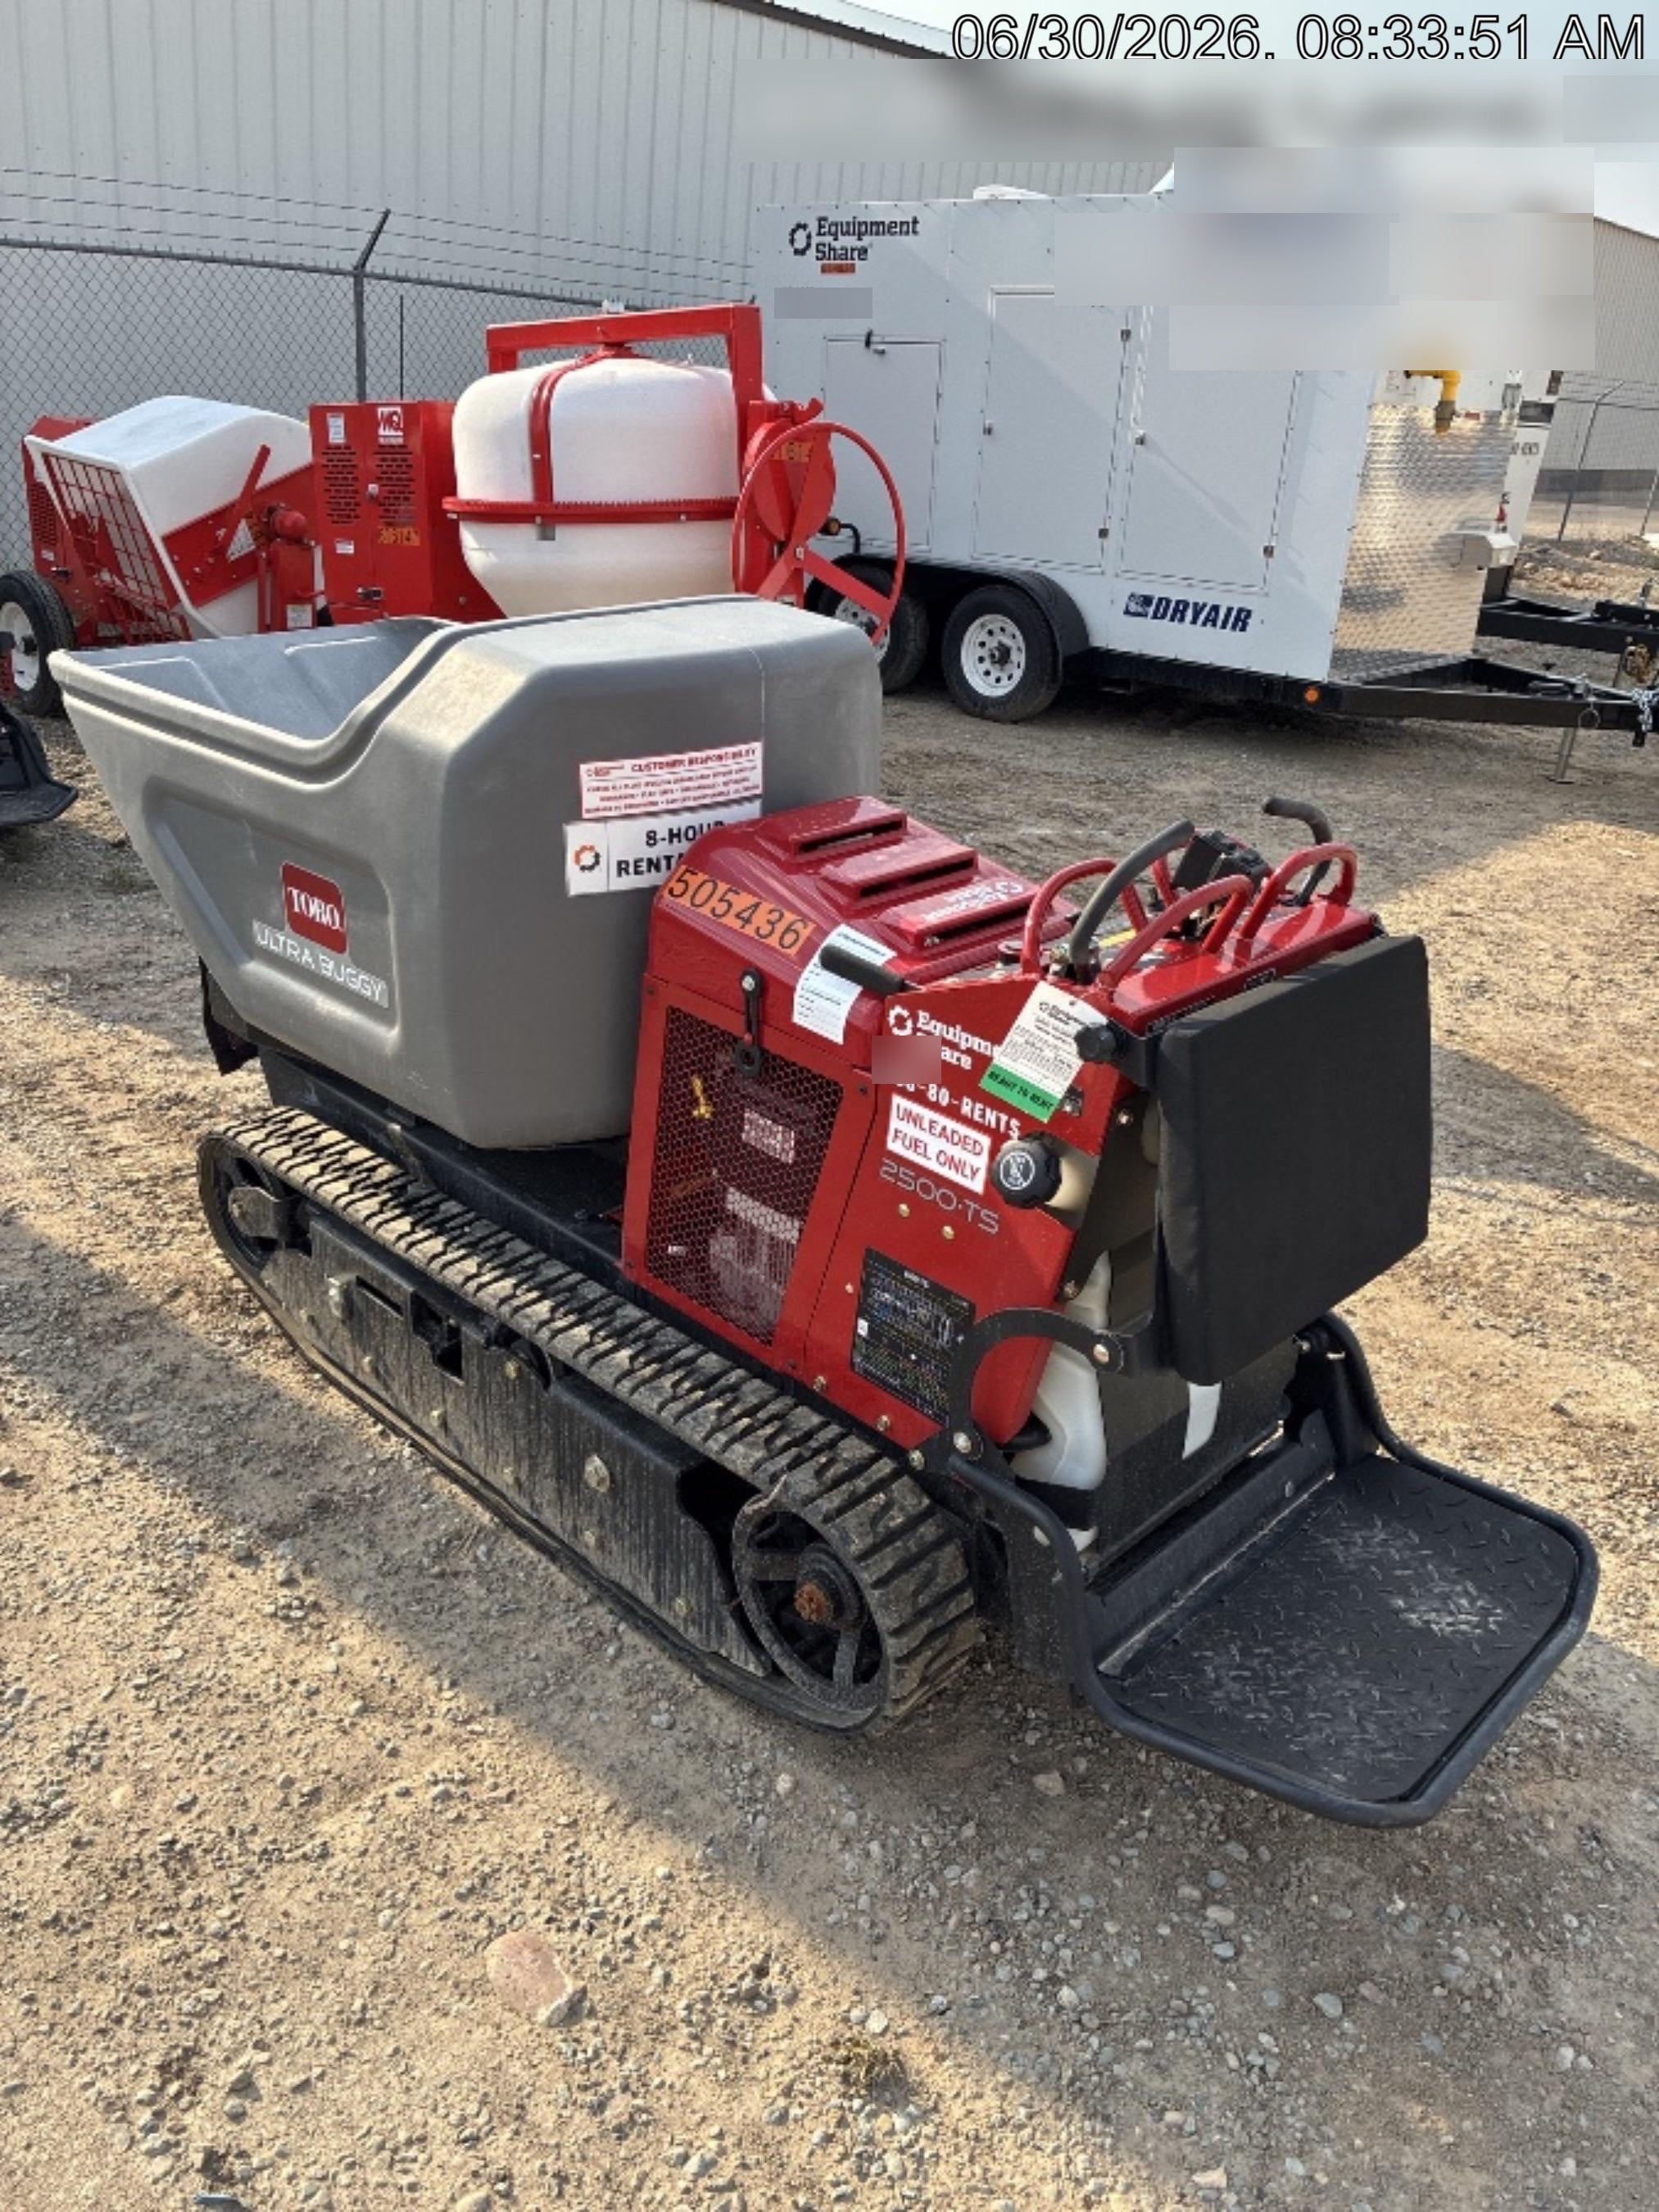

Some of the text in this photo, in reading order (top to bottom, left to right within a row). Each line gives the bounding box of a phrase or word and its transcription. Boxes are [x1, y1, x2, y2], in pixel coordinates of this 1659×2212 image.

[815, 215, 920, 241] Equipment
[815, 243, 868, 261] Share
[1150, 596, 1253, 632] DRYAIR
[616, 853, 683, 878] RENT
[288, 886, 344, 931] TORO
[668, 868, 809, 950] 505436
[255, 926, 388, 1001] ULTRA BUGGY
[916, 1009, 1001, 1058] Equipm
[895, 1103, 984, 1156] UNLEADED
[891, 1127, 931, 1161] FUEL
[936, 1149, 981, 1181] ONLY
